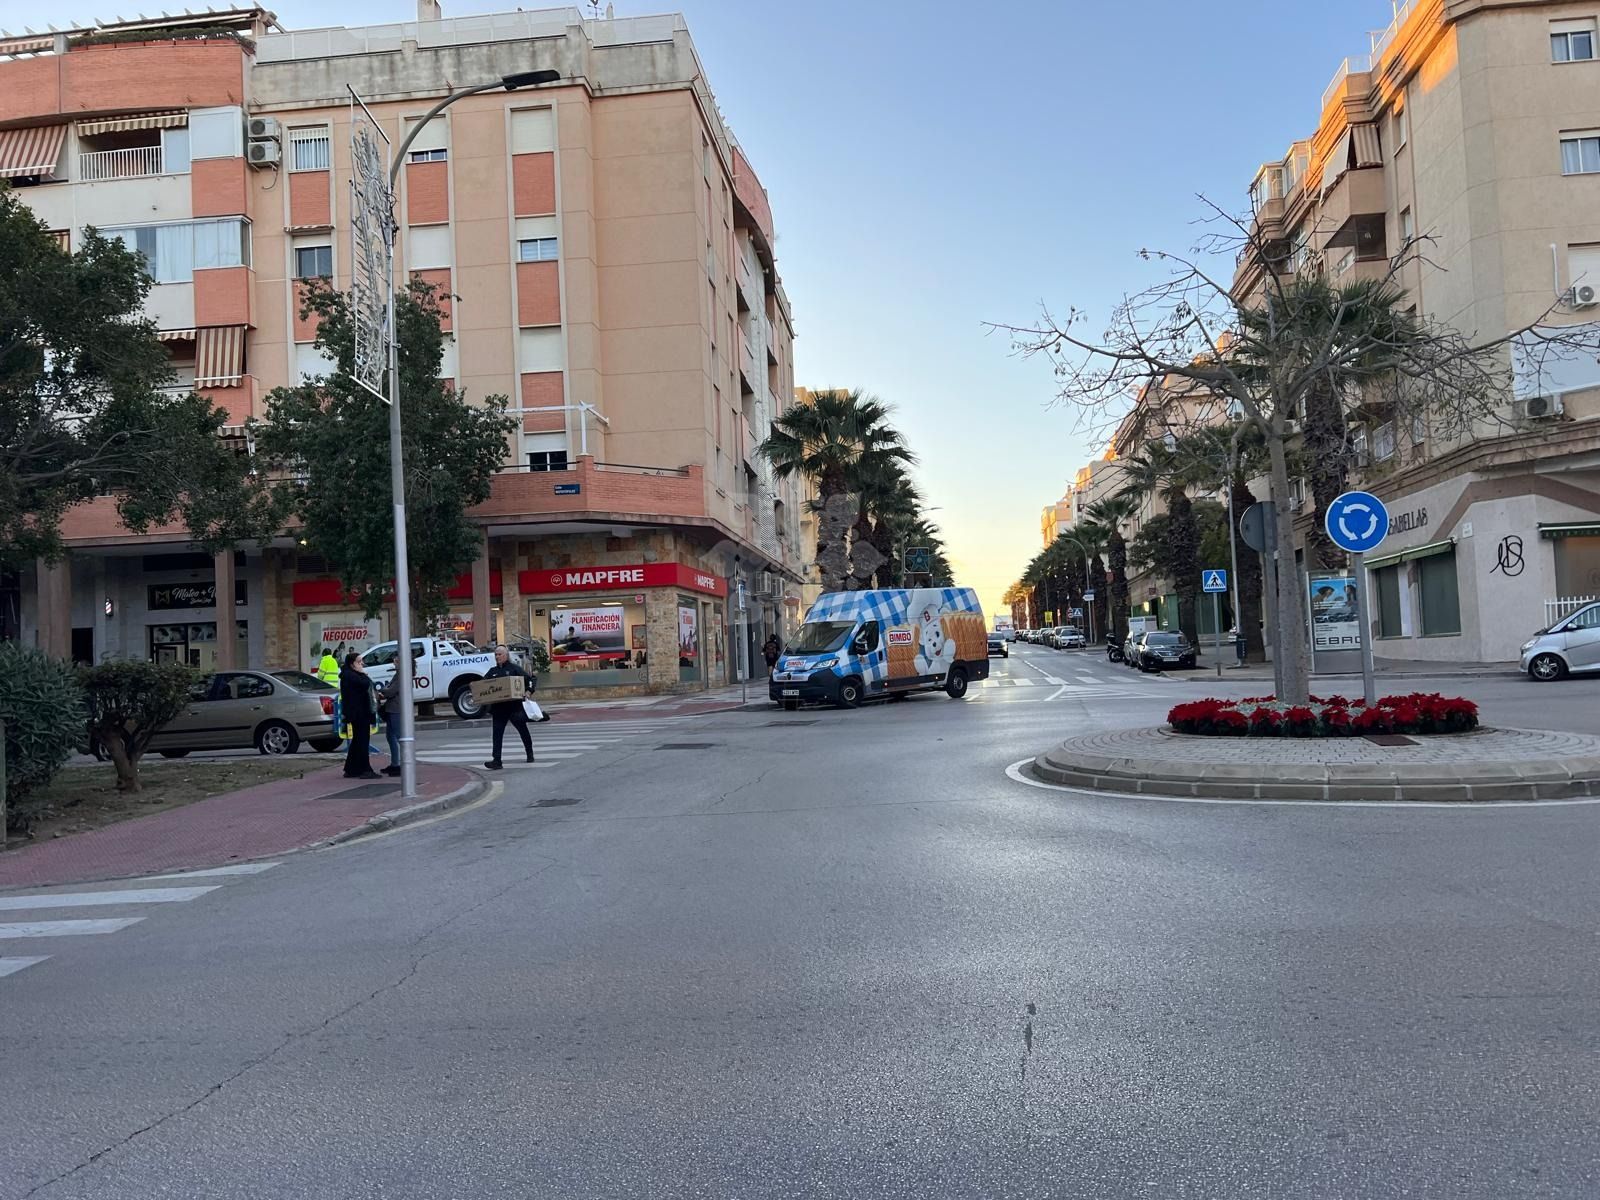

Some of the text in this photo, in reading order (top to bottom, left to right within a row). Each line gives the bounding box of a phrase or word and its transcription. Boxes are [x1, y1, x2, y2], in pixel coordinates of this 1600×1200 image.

[566, 569, 644, 586] MAPFRE
[697, 574, 715, 590] MAPFRE
[571, 613, 620, 624] PLANIFICACIÓN
[582, 623, 620, 632] FINANCIERA
[323, 629, 368, 642] NEGOCIO?
[889, 632, 912, 642] BIMBO
[442, 656, 489, 667] ASISTENCIA
